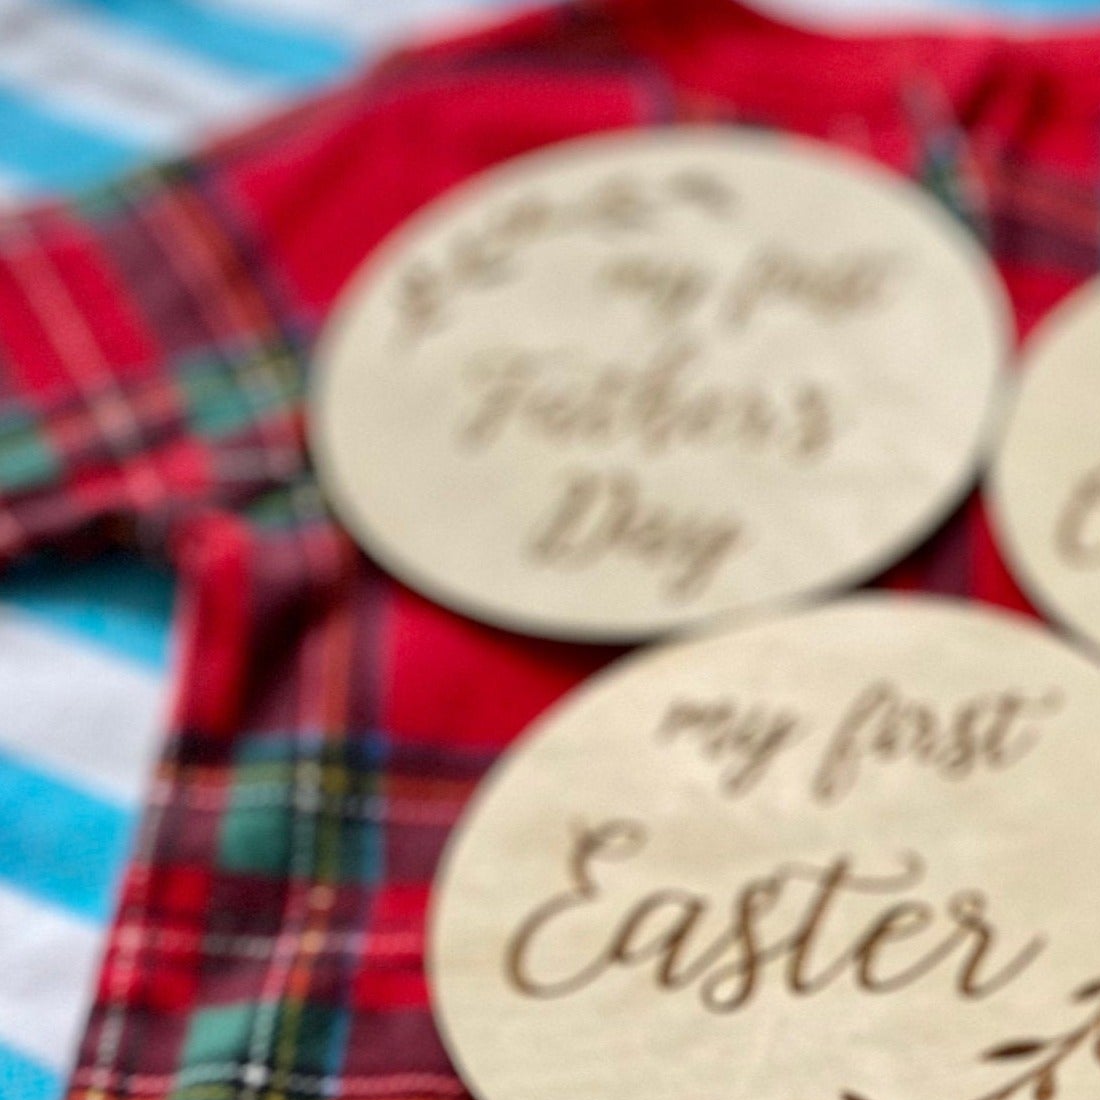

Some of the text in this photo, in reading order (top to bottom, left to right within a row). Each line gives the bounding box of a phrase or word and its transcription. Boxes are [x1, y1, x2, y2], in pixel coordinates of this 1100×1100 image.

[656, 680, 1064, 804] my first
[504, 814, 1047, 1012] Easter
